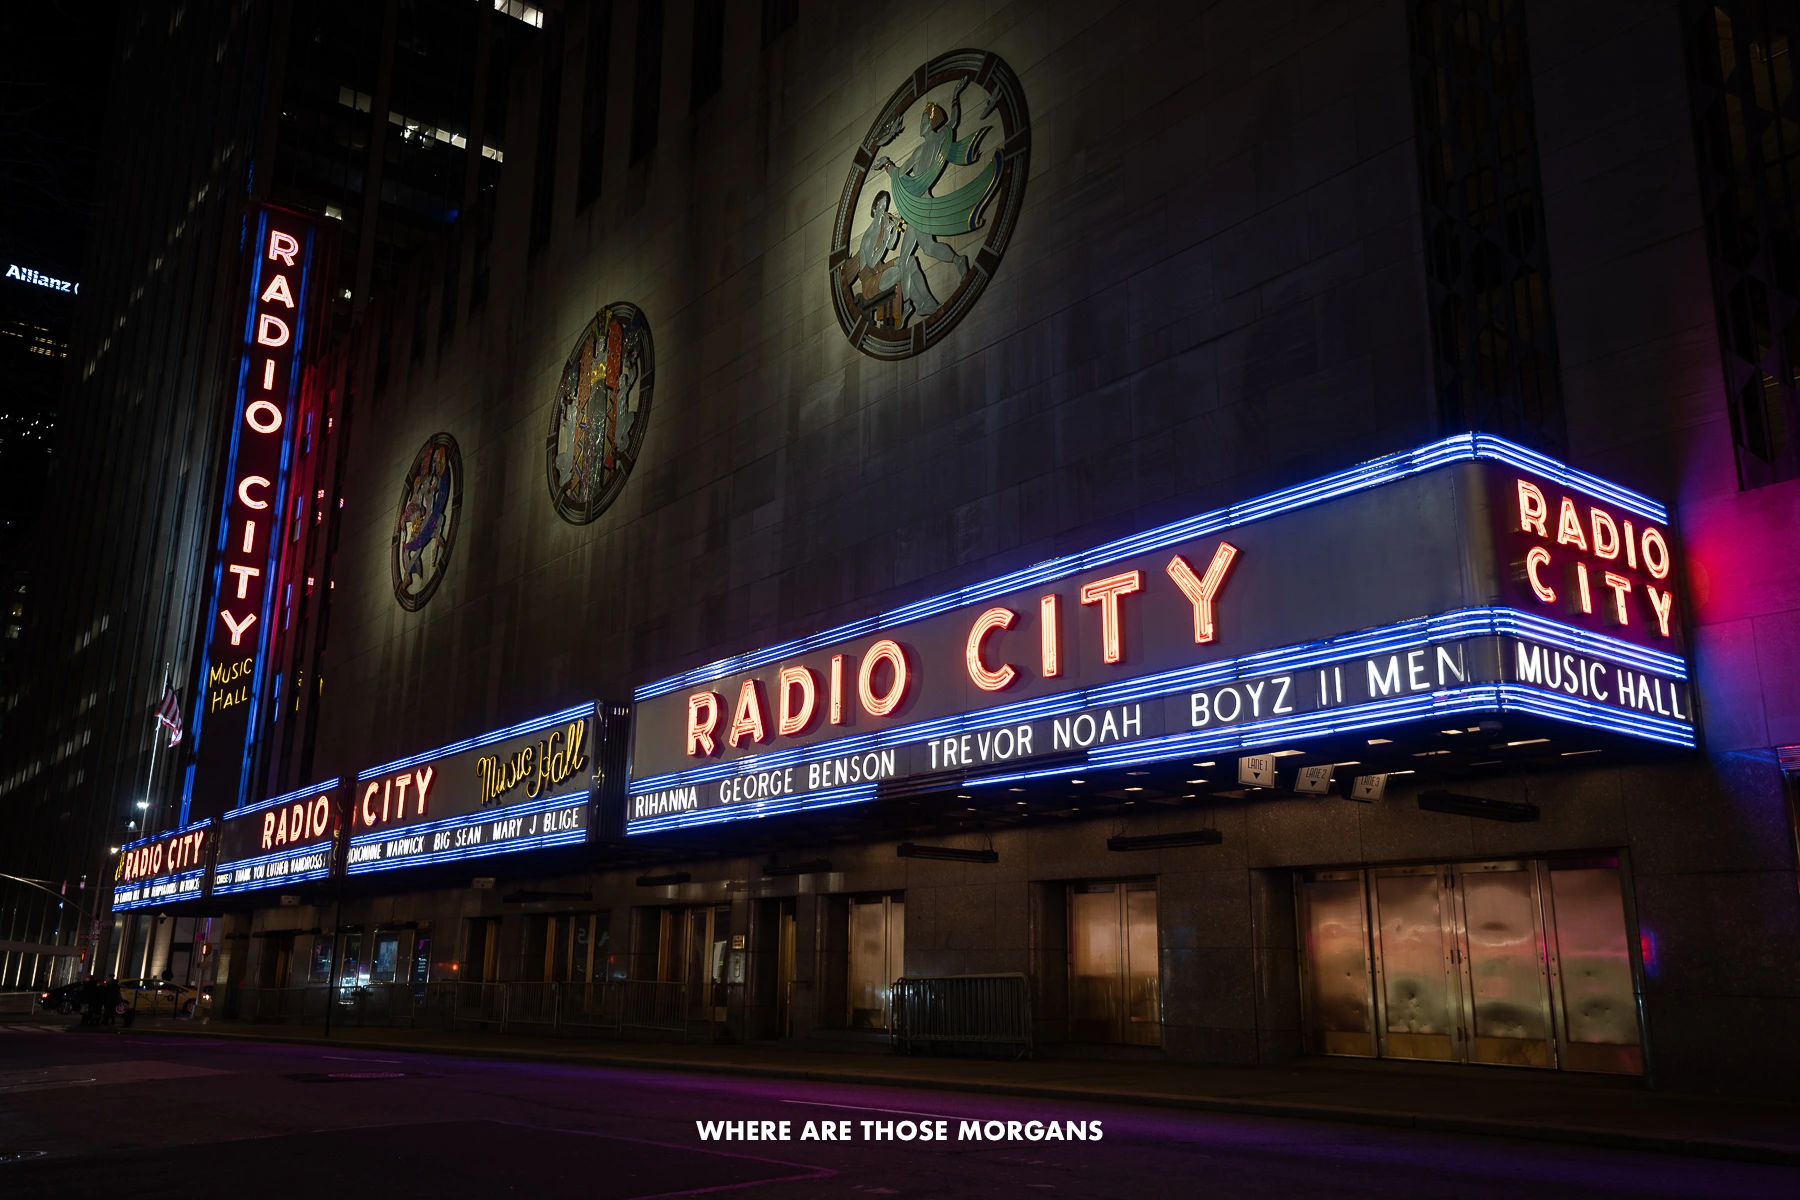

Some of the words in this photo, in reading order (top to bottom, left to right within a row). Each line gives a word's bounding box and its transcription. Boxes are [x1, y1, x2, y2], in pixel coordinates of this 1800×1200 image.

[5, 264, 71, 293] Allianz
[245, 230, 299, 434] RADIO
[1517, 478, 1670, 580] RADIO
[220, 475, 271, 646] CITY
[1526, 546, 1672, 637] CITY
[209, 658, 253, 688] MUSIC
[687, 639, 907, 756] RADIO
[966, 541, 1238, 692] CITY
[211, 686, 248, 713] HALL
[1517, 641, 1609, 701] MUSIC
[1616, 669, 1687, 720] HALL
[635, 786, 698, 818] RIHANNA
[719, 767, 794, 804] GEORGE
[808, 750, 895, 789] BENSON
[928, 724, 1033, 770] TREVOR
[1053, 704, 1141, 750] NOAH
[1190, 676, 1293, 727] BOYZ
[1320, 667, 1342, 705] II
[1367, 643, 1465, 697] MEN
[363, 765, 434, 827] CITY
[477, 747, 532, 804] Music
[526, 719, 584, 798] Hall
[1247, 757, 1263, 770] LANE
[1264, 760, 1268, 771] 1
[1305, 767, 1322, 778] LANE
[1322, 768, 1327, 779] 2
[1361, 775, 1375, 785] LANE
[1375, 777, 1381, 787] 3
[262, 796, 330, 849] RADIO
[350, 843, 382, 864] DIONNE
[386, 836, 425, 858] WARWICK
[433, 832, 450, 851] BIG
[455, 825, 482, 847] SEAN
[492, 817, 523, 840] MARY
[528, 814, 537, 834] J
[543, 807, 579, 832] BLIGE
[125, 844, 163, 881] RADIO
[168, 830, 204, 870] CITY
[253, 864, 266, 879] YOU
